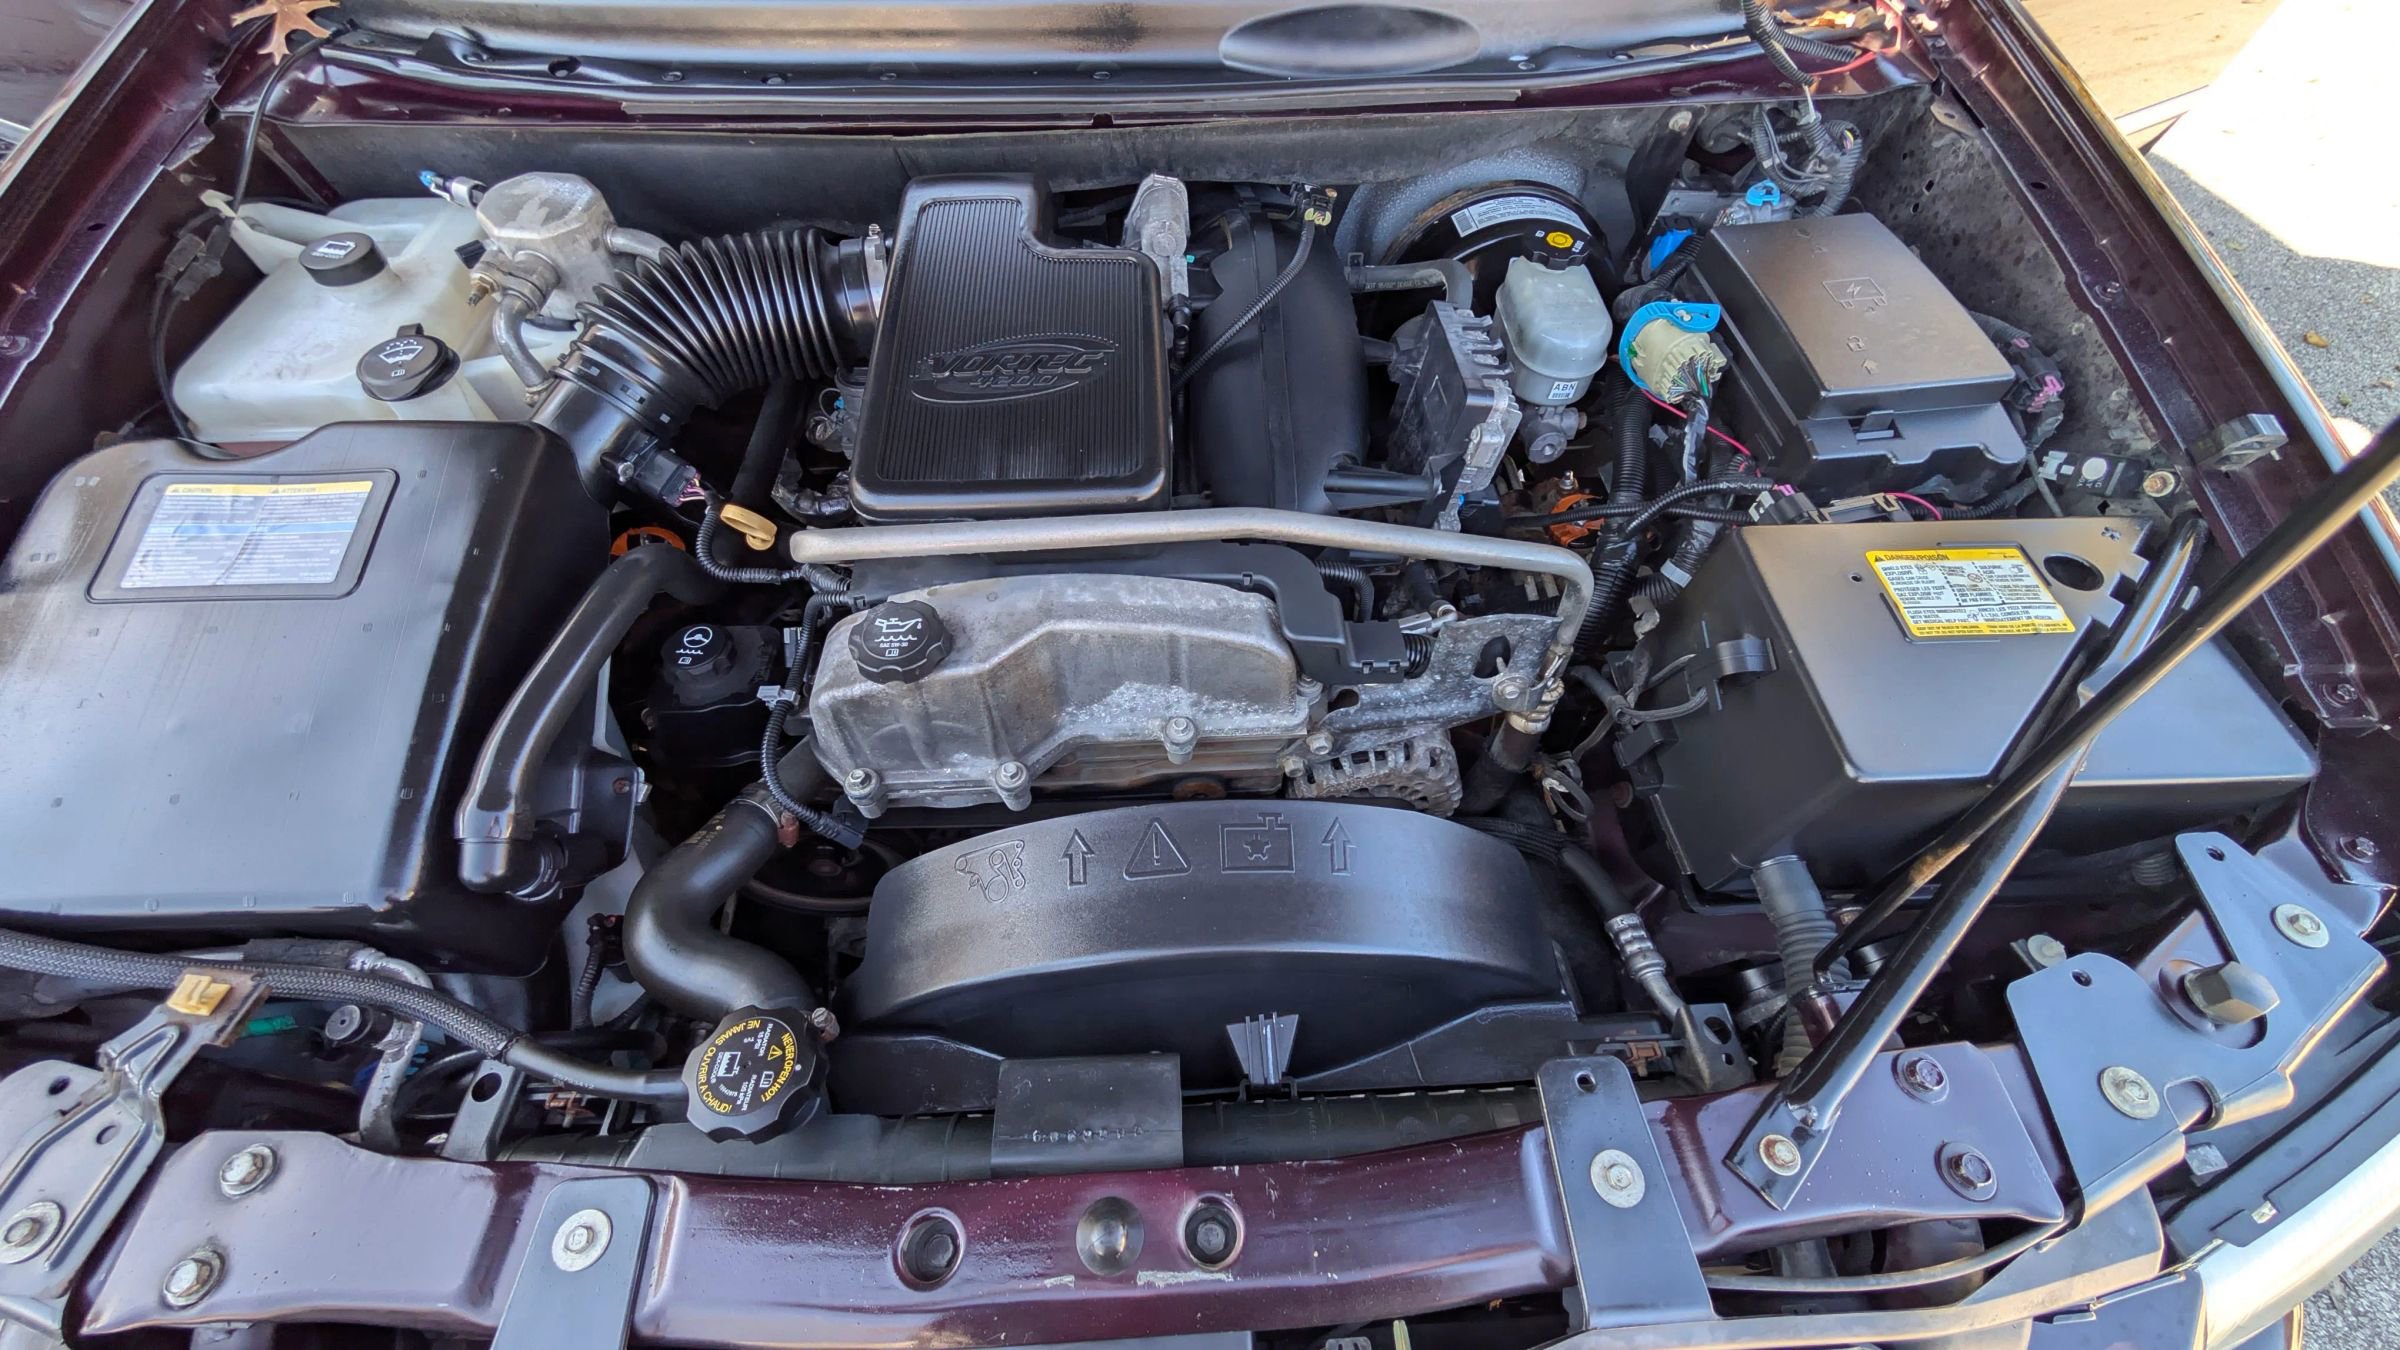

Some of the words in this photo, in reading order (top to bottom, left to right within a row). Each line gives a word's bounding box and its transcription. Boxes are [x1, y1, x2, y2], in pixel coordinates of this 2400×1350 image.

[928, 350, 1106, 379] VORTEC
[969, 375, 1058, 389] 4200
[1553, 383, 1577, 391] ABN
[715, 1022, 746, 1046] JAMAIS
[746, 1020, 761, 1030] NE
[754, 1038, 763, 1050] PSI
[758, 1023, 774, 1057] RADIATOR
[781, 1032, 795, 1059] NEVER
[698, 1046, 716, 1085] OUVRIR
[776, 1060, 794, 1084] OPEN
[703, 1091, 732, 1114] CHAUD!
[741, 1074, 757, 1111] RADIATEUR
[760, 1082, 782, 1103] HOT!
